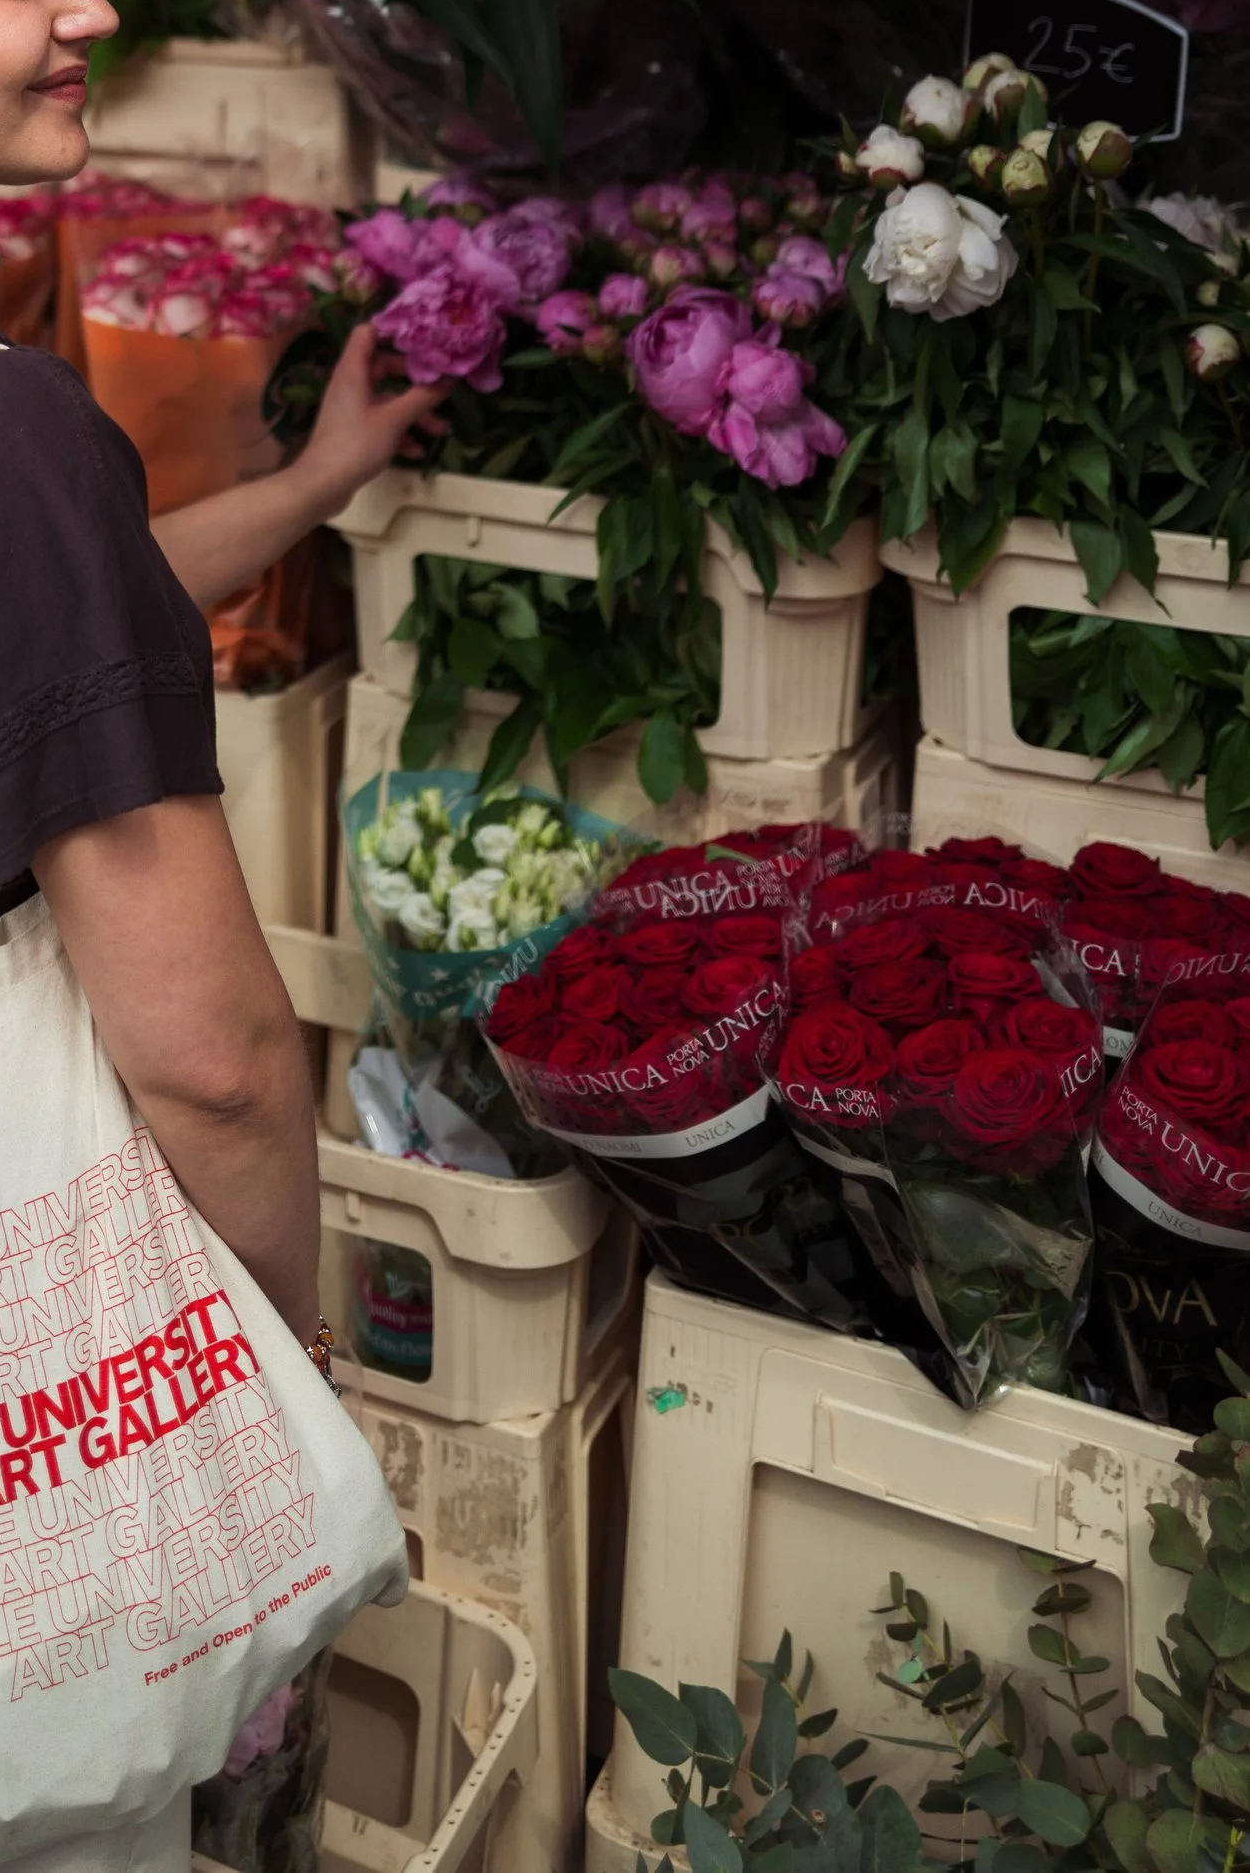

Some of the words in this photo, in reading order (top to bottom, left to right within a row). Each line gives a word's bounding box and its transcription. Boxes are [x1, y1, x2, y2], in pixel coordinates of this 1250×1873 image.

[1024, 15, 1136, 84] 25€
[704, 980, 787, 1053] UNICA
[566, 1063, 669, 1096] UNICA
[666, 1037, 705, 1066] PORTA
[672, 1052, 711, 1078] NOVA
[835, 1087, 877, 1104] PORTA
[838, 1101, 880, 1119] NOVA
[1117, 1096, 1153, 1136] NOVA
[1121, 1086, 1158, 1125] PORTA
[686, 1118, 737, 1148] UNICA
[44, 1168, 188, 1285] GALLER
[65, 1252, 221, 1374] GALLER
[25, 1369, 277, 1539] UNIVERSITY
[105, 1407, 291, 1559] GALLERY
[48, 1449, 304, 1634] UNIVERSITY
[11, 1616, 115, 1702] ART
[126, 1492, 317, 1652] GALLERY
[144, 1662, 178, 1686] Free
[182, 1643, 210, 1667] and
[212, 1623, 253, 1649] Open
[254, 1609, 267, 1626] to
[268, 1593, 291, 1614] the
[291, 1563, 332, 1599] Public
